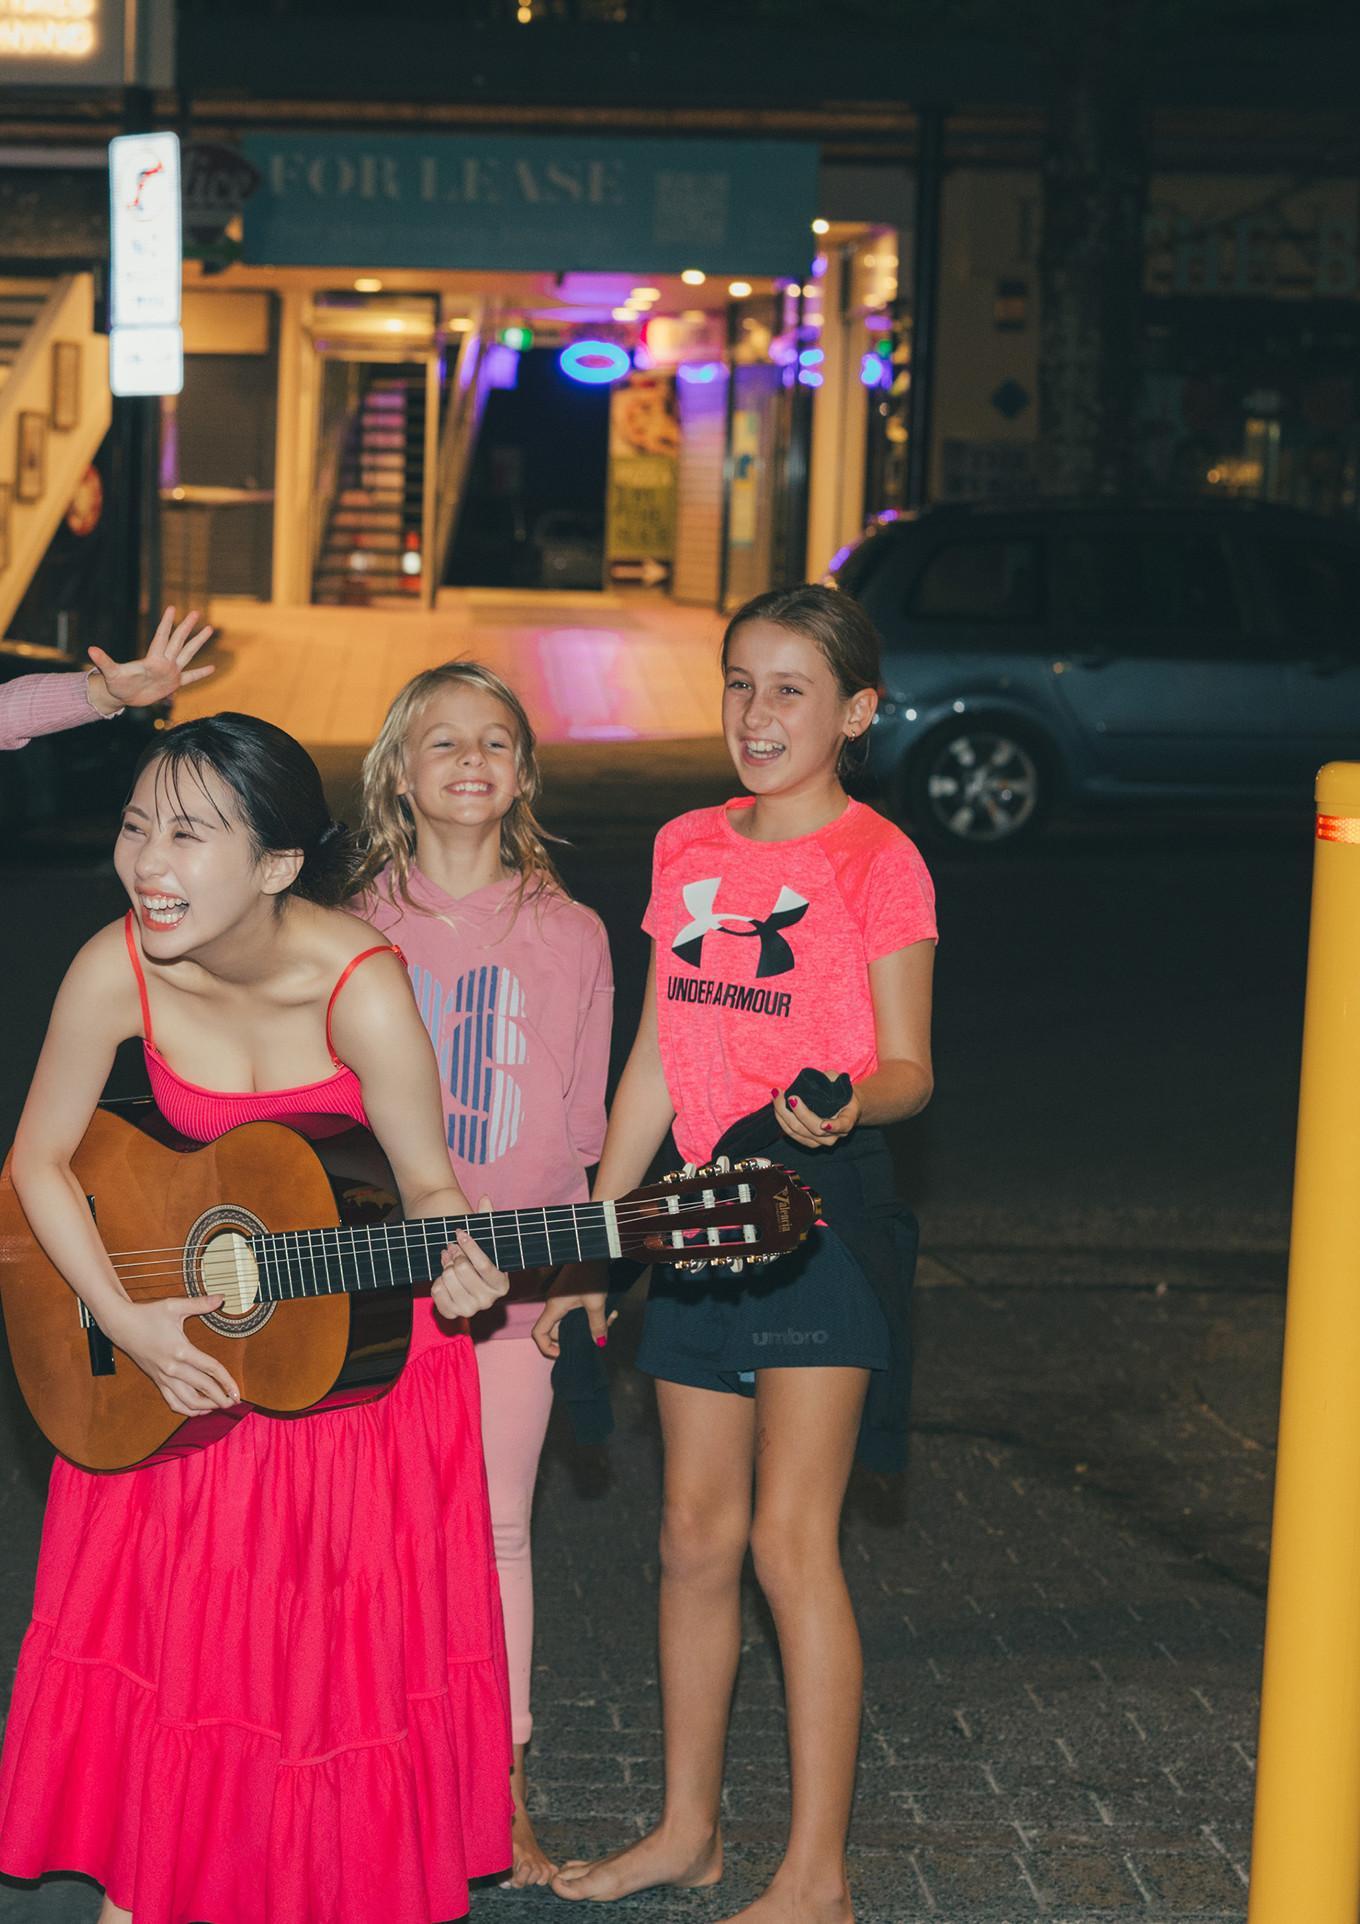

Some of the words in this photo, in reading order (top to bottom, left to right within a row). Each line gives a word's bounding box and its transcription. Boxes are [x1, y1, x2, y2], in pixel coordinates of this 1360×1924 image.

[268, 153, 399, 199] FOR
[420, 157, 625, 206] LEASE
[752, 1328, 829, 1346] umbro
